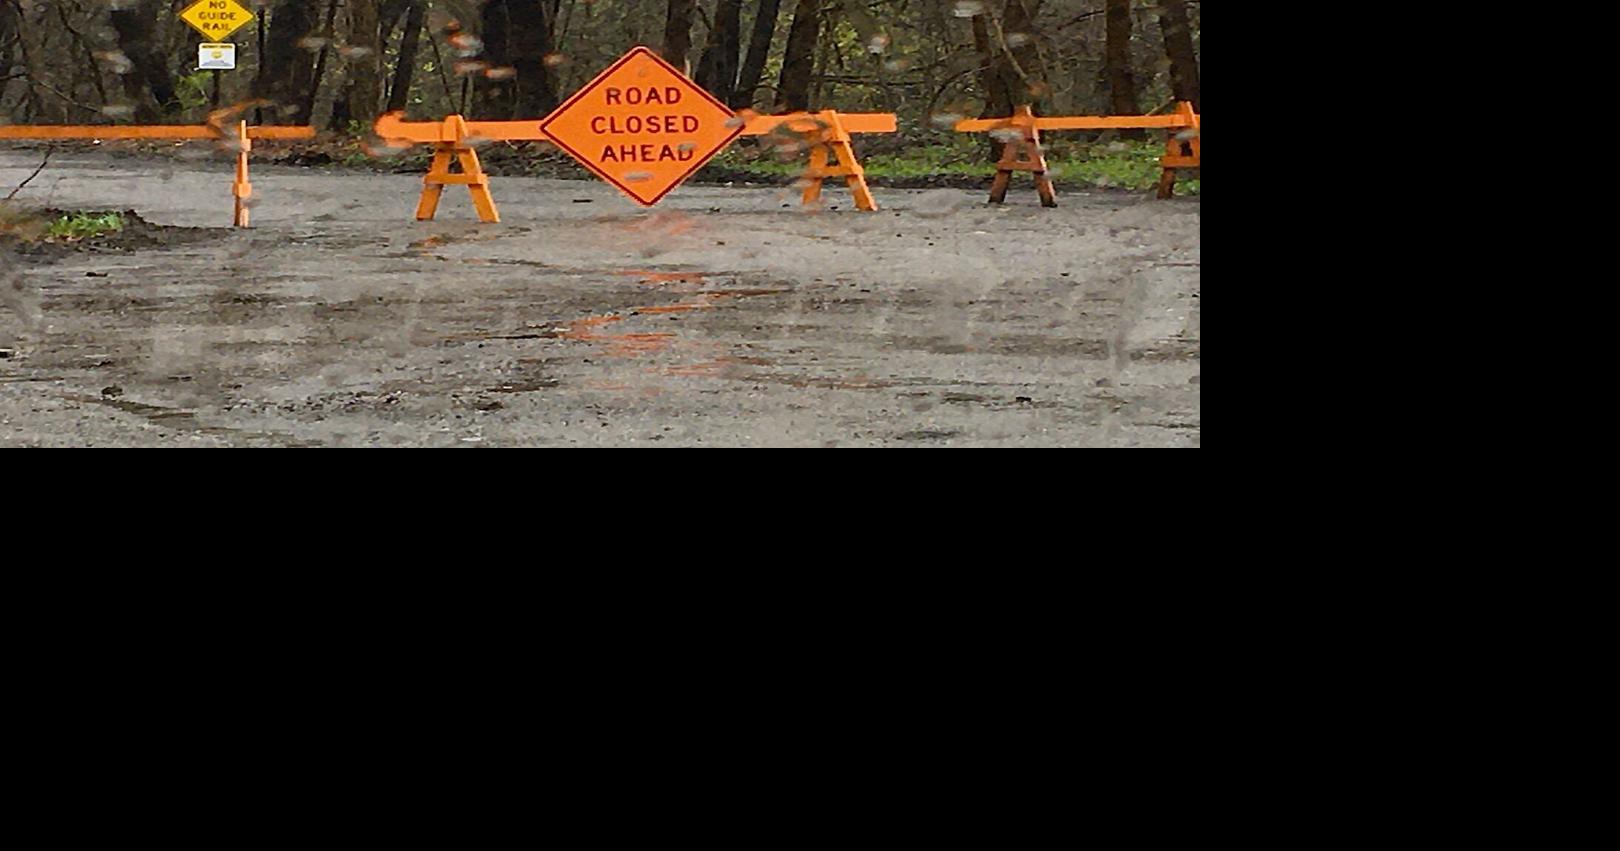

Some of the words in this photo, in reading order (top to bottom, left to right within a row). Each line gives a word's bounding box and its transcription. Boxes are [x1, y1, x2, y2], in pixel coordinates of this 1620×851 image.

[209, 1, 226, 9] NO
[198, 11, 237, 20] GUIDE
[202, 23, 232, 31] RAIL
[606, 87, 682, 105] ROAD
[591, 115, 699, 134] CLOSED
[600, 144, 694, 162] AHEAD
